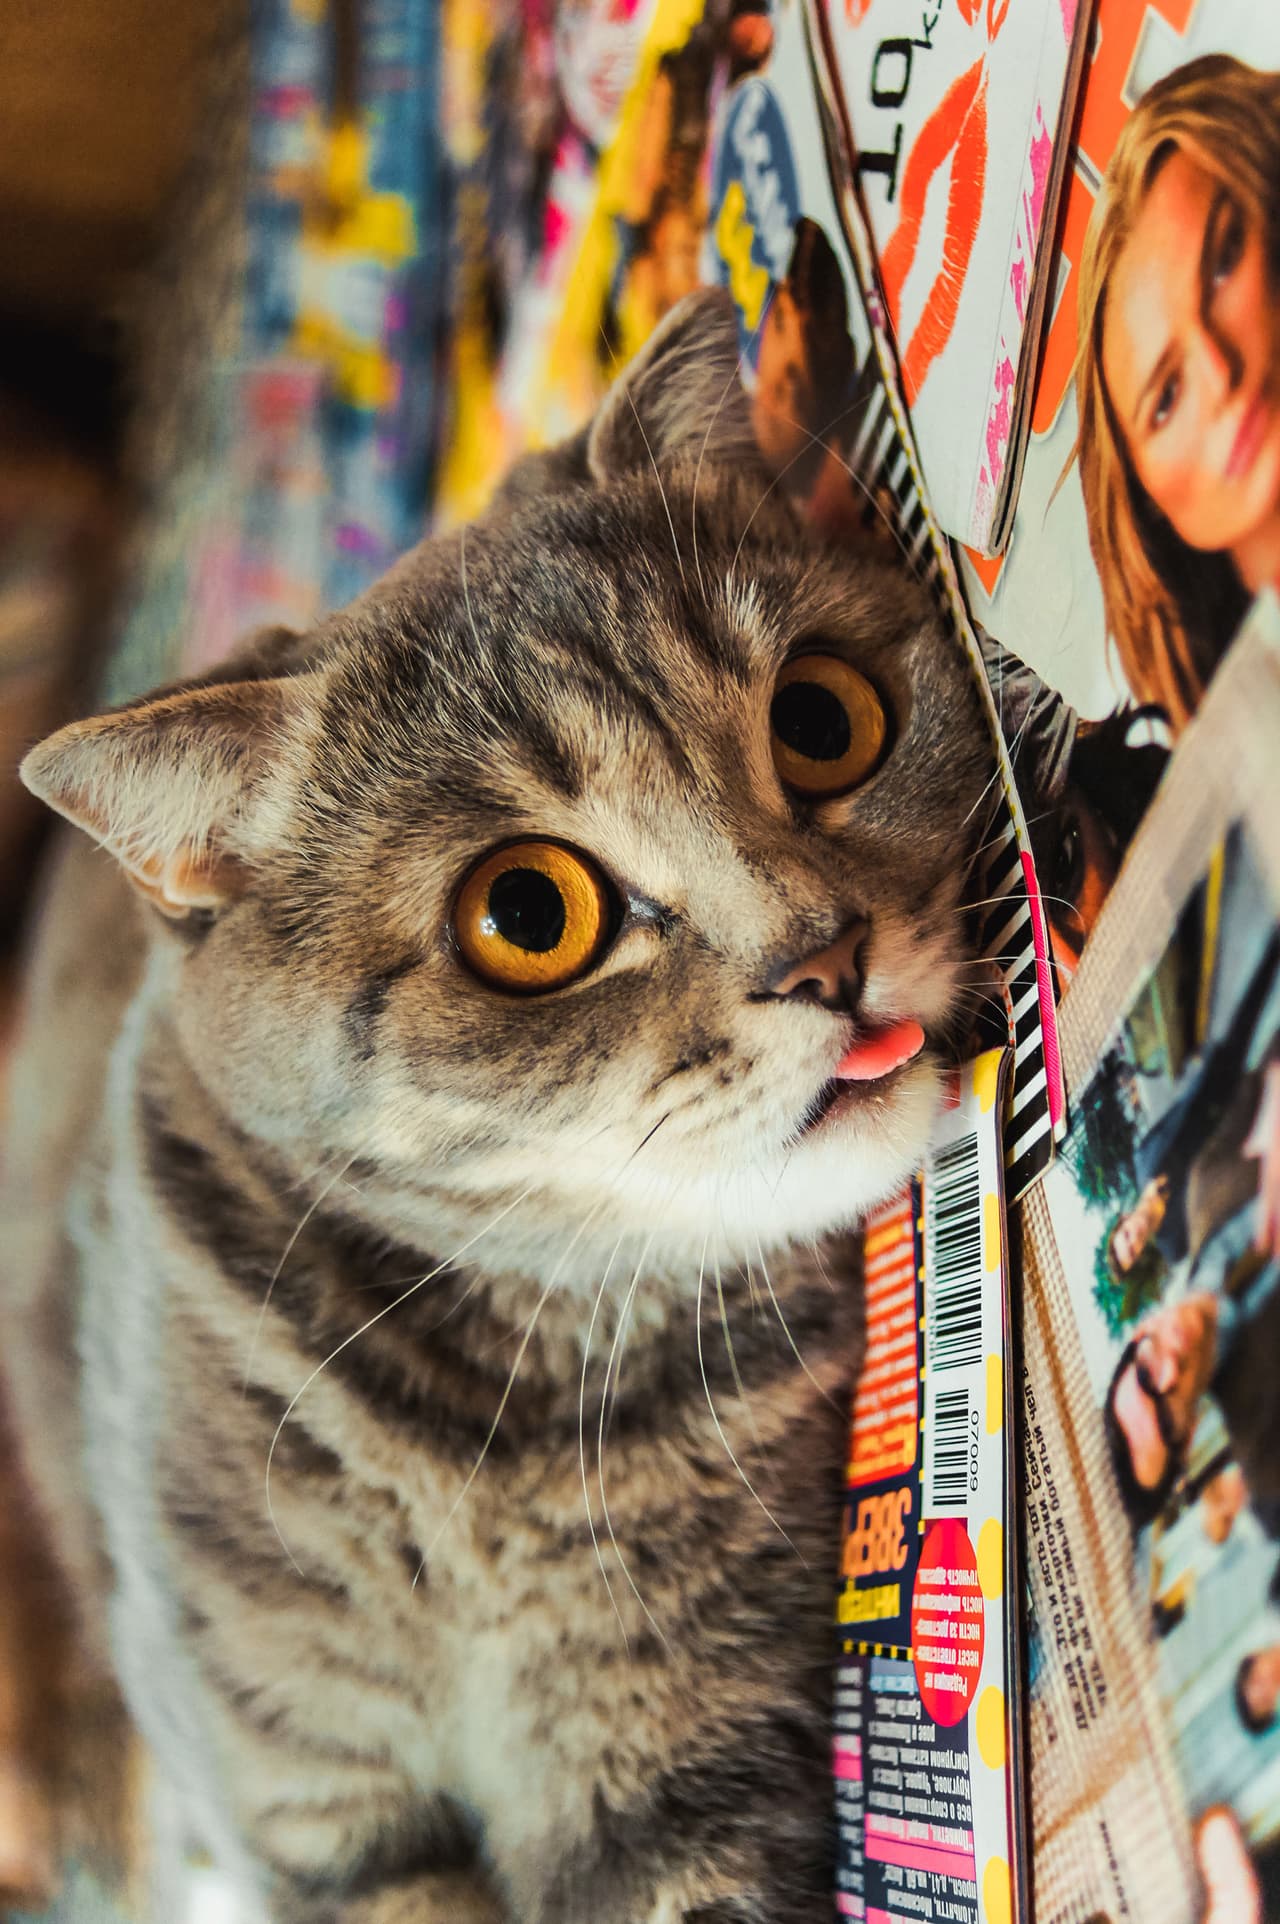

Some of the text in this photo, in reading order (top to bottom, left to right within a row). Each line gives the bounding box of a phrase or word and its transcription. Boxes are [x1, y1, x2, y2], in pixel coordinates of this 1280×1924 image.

[1023, 1383, 1038, 1422] чел
[968, 1409, 981, 1492] 07009
[1031, 1424, 1060, 1512] богатый
[1026, 1502, 1041, 1537] тот
[1036, 1541, 1054, 1588] есть
[1052, 1517, 1078, 1587] самый
[947, 1568, 978, 1587] точность
[1038, 1493, 1080, 1648] фотокарточки.
[961, 1596, 983, 1614] ность
[1048, 1594, 1059, 1608] и
[950, 1621, 958, 1638] за
[959, 1622, 980, 1641] ности
[957, 1649, 979, 1667] несет
[923, 1671, 933, 1689] не
[934, 1671, 968, 1697] Редакция
[930, 1749, 969, 1774] фигурном
[932, 1773, 970, 1800] Круглове,
[950, 1804, 955, 1820] о
[957, 1804, 972, 1823] все
